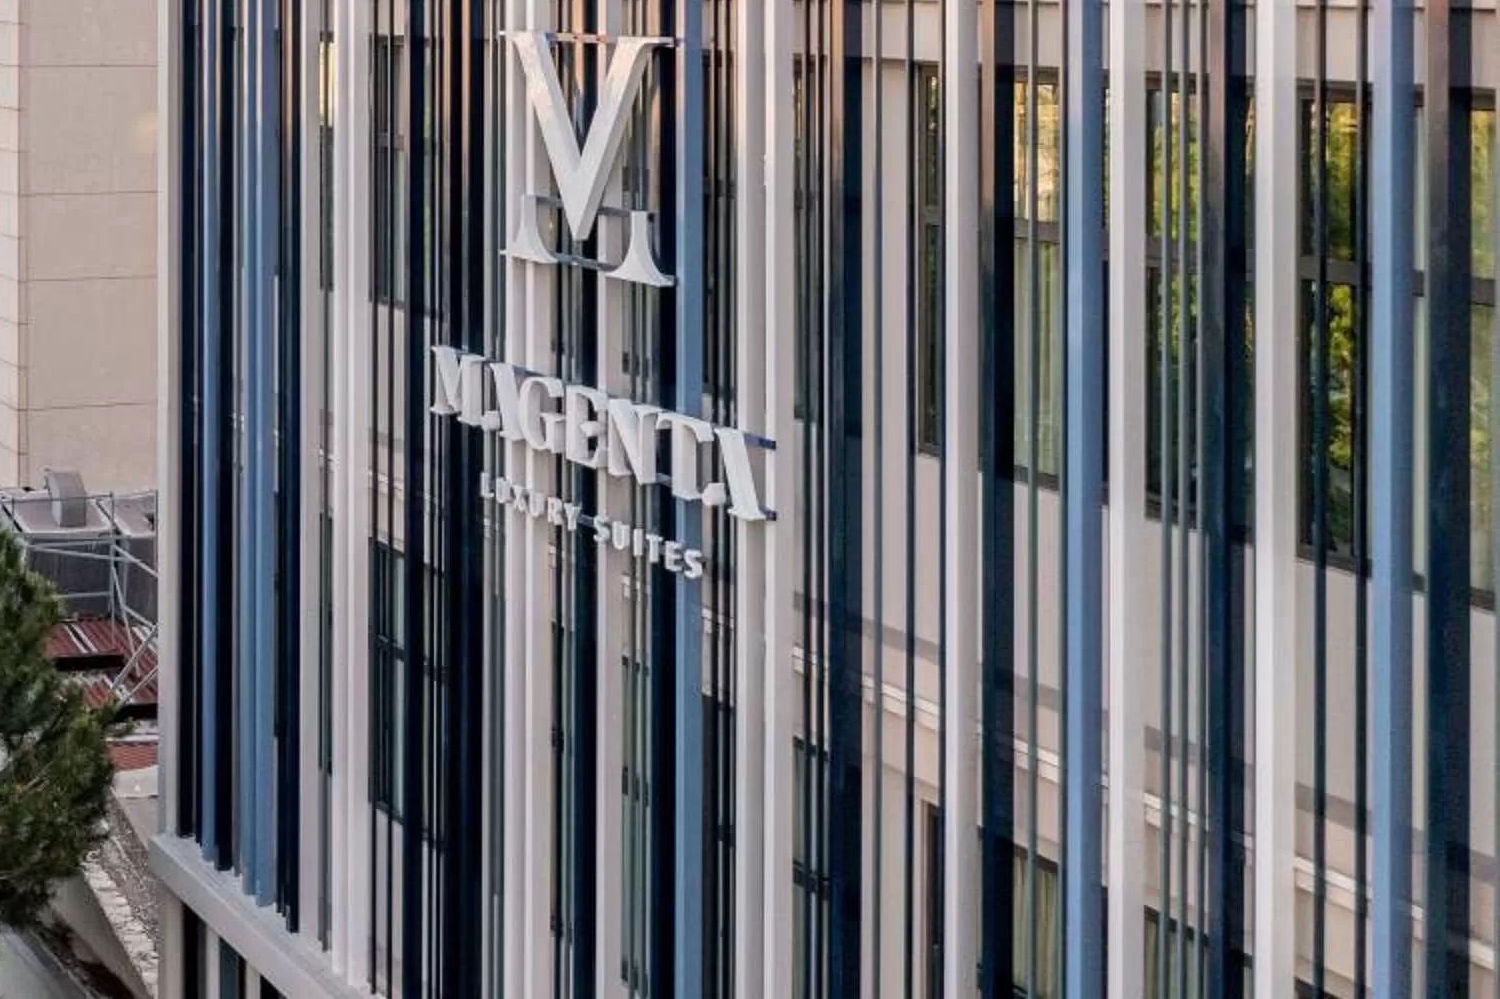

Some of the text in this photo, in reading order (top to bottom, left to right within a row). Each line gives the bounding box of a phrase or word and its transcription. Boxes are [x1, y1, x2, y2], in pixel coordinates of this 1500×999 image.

[430, 345, 767, 521] MAGENTA
[480, 472, 703, 579] LUXURY SUITES
